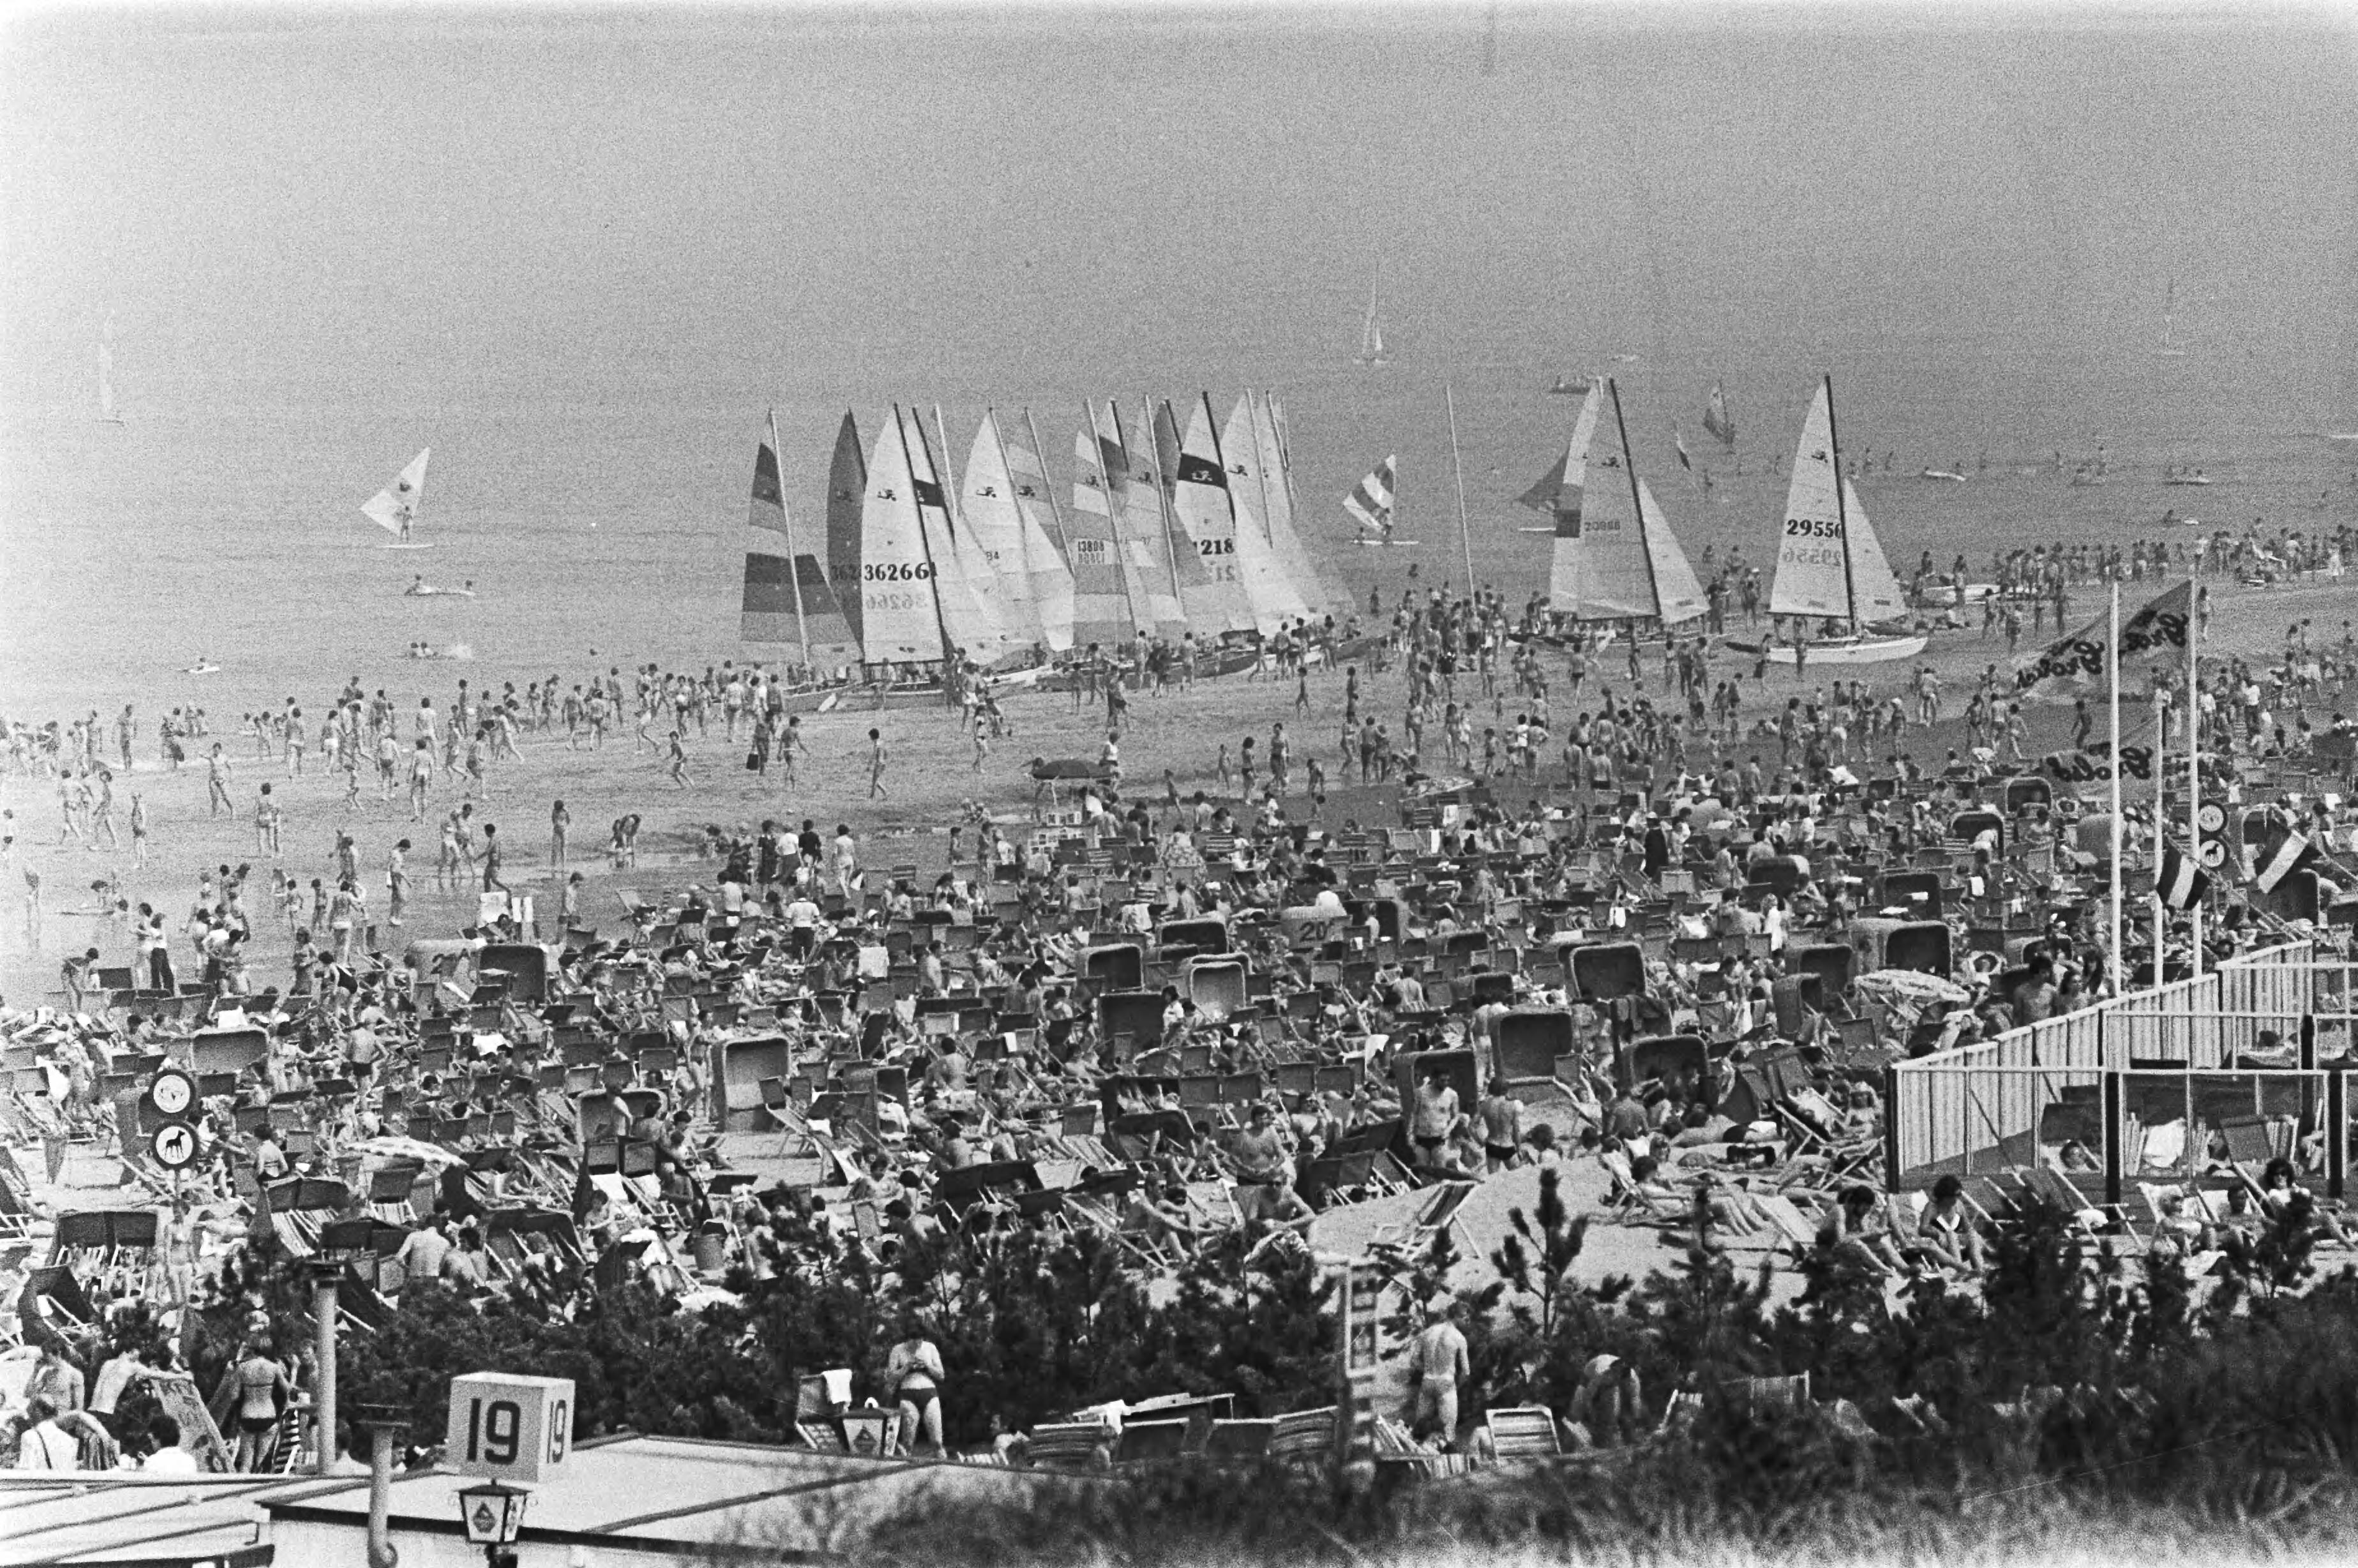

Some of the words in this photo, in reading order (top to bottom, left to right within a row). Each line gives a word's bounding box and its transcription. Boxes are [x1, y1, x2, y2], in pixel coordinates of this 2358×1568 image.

[864, 562, 929, 581] 36266
[467, 1398, 520, 1464] 19
[546, 1400, 566, 1463] 19
